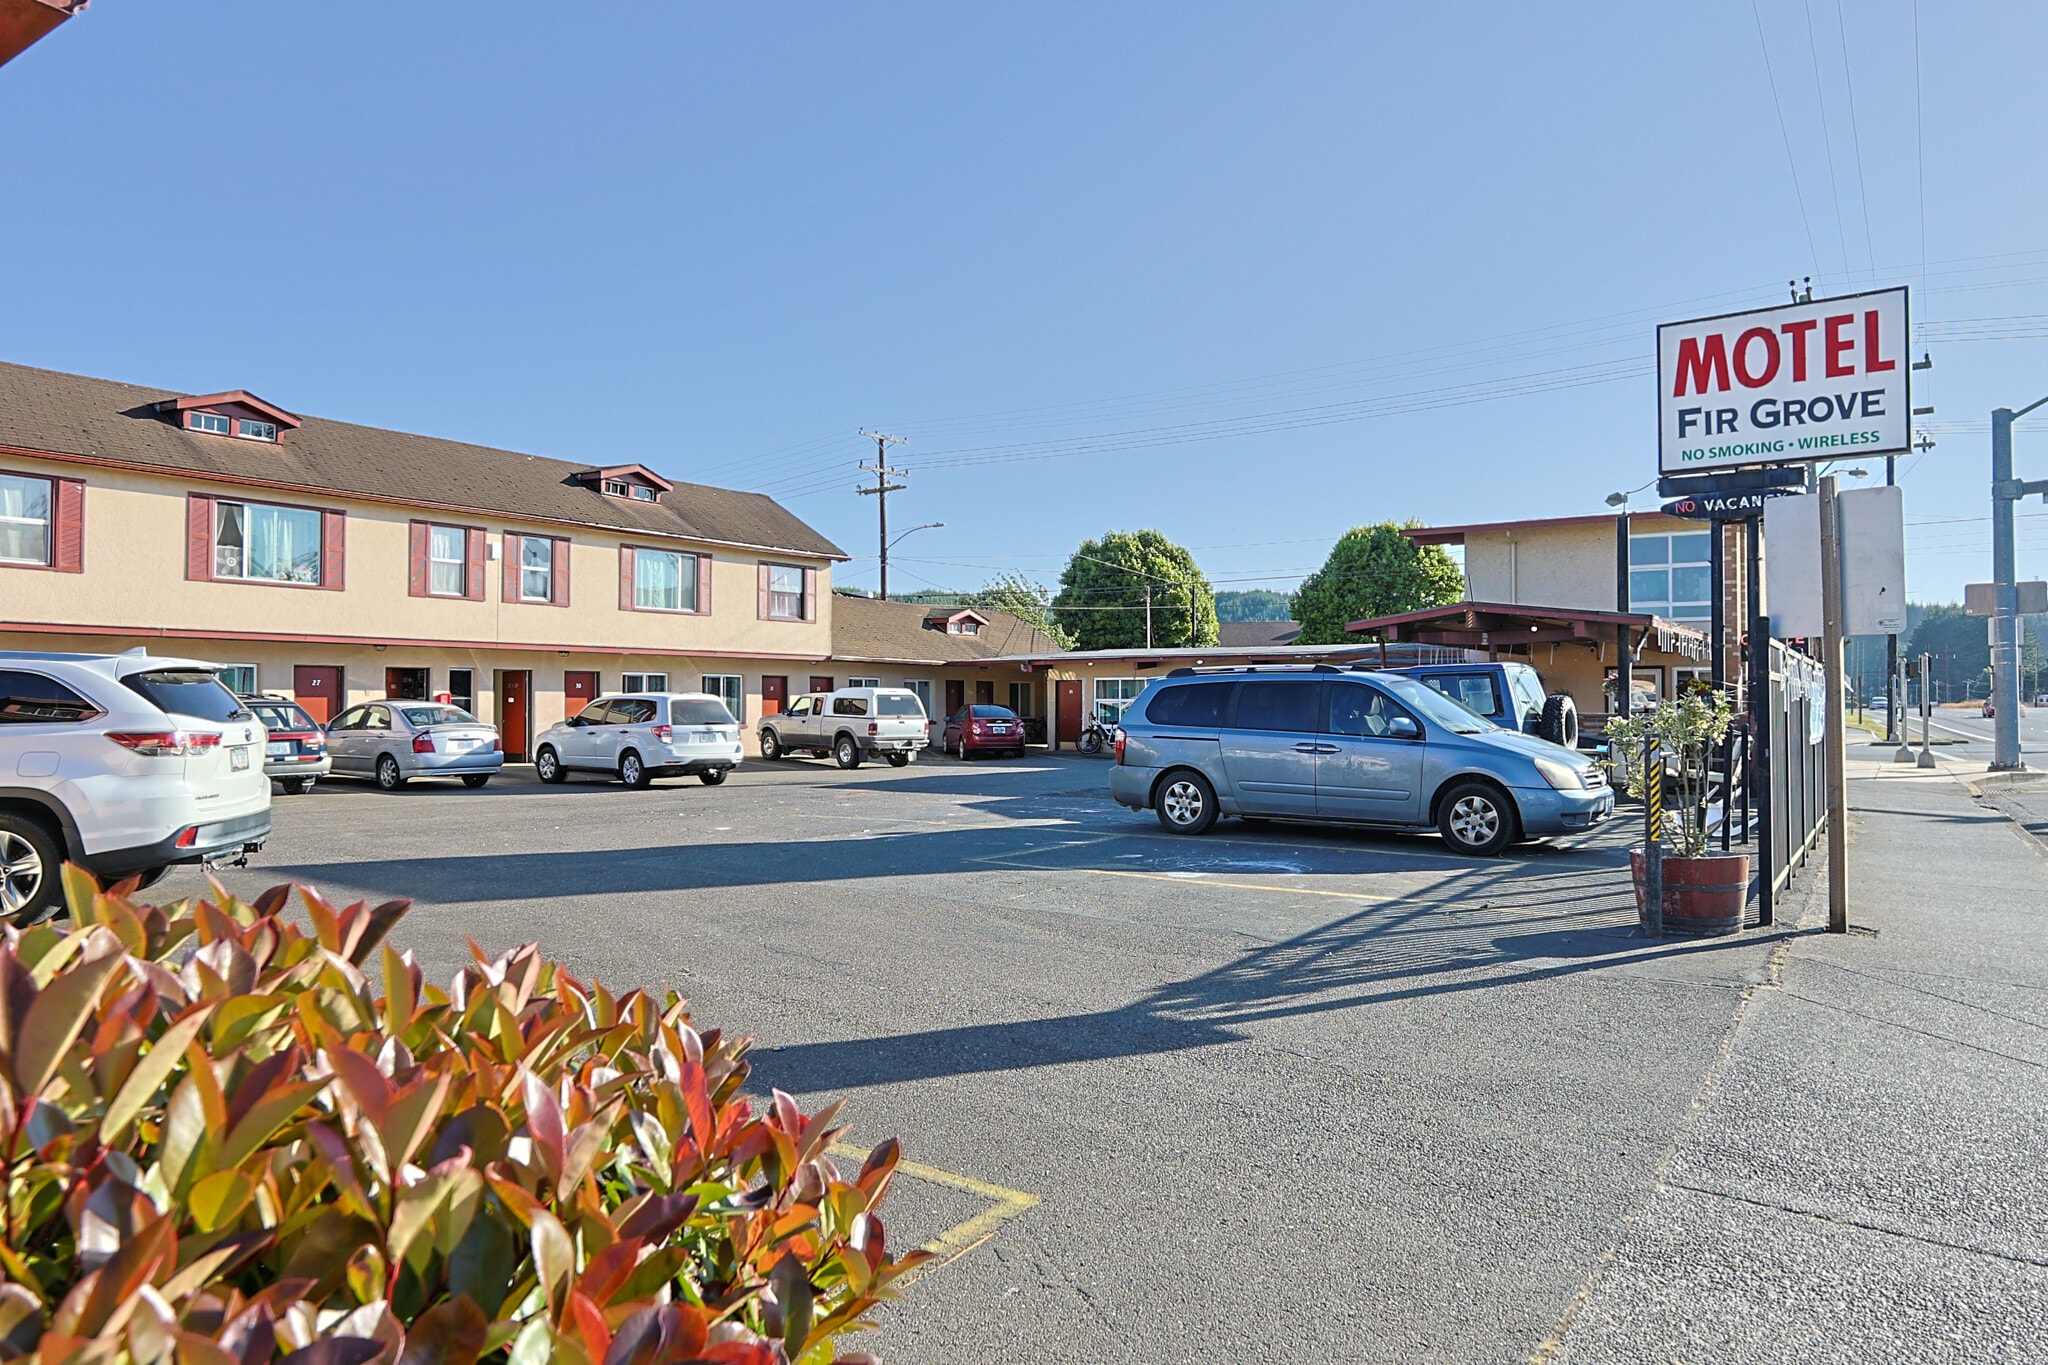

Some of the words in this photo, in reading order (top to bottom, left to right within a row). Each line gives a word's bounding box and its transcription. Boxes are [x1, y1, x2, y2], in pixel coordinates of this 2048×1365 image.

[1673, 310, 1895, 397] MOTEL
[1677, 406, 1739, 439] FIR
[1750, 388, 1886, 429] GROVE
[1681, 449, 1705, 461] NO
[1708, 440, 1784, 458] SMOKING
[1797, 430, 1880, 449] WIRELESS
[1675, 501, 1696, 513] NO
[1704, 493, 1787, 511] VACAN
